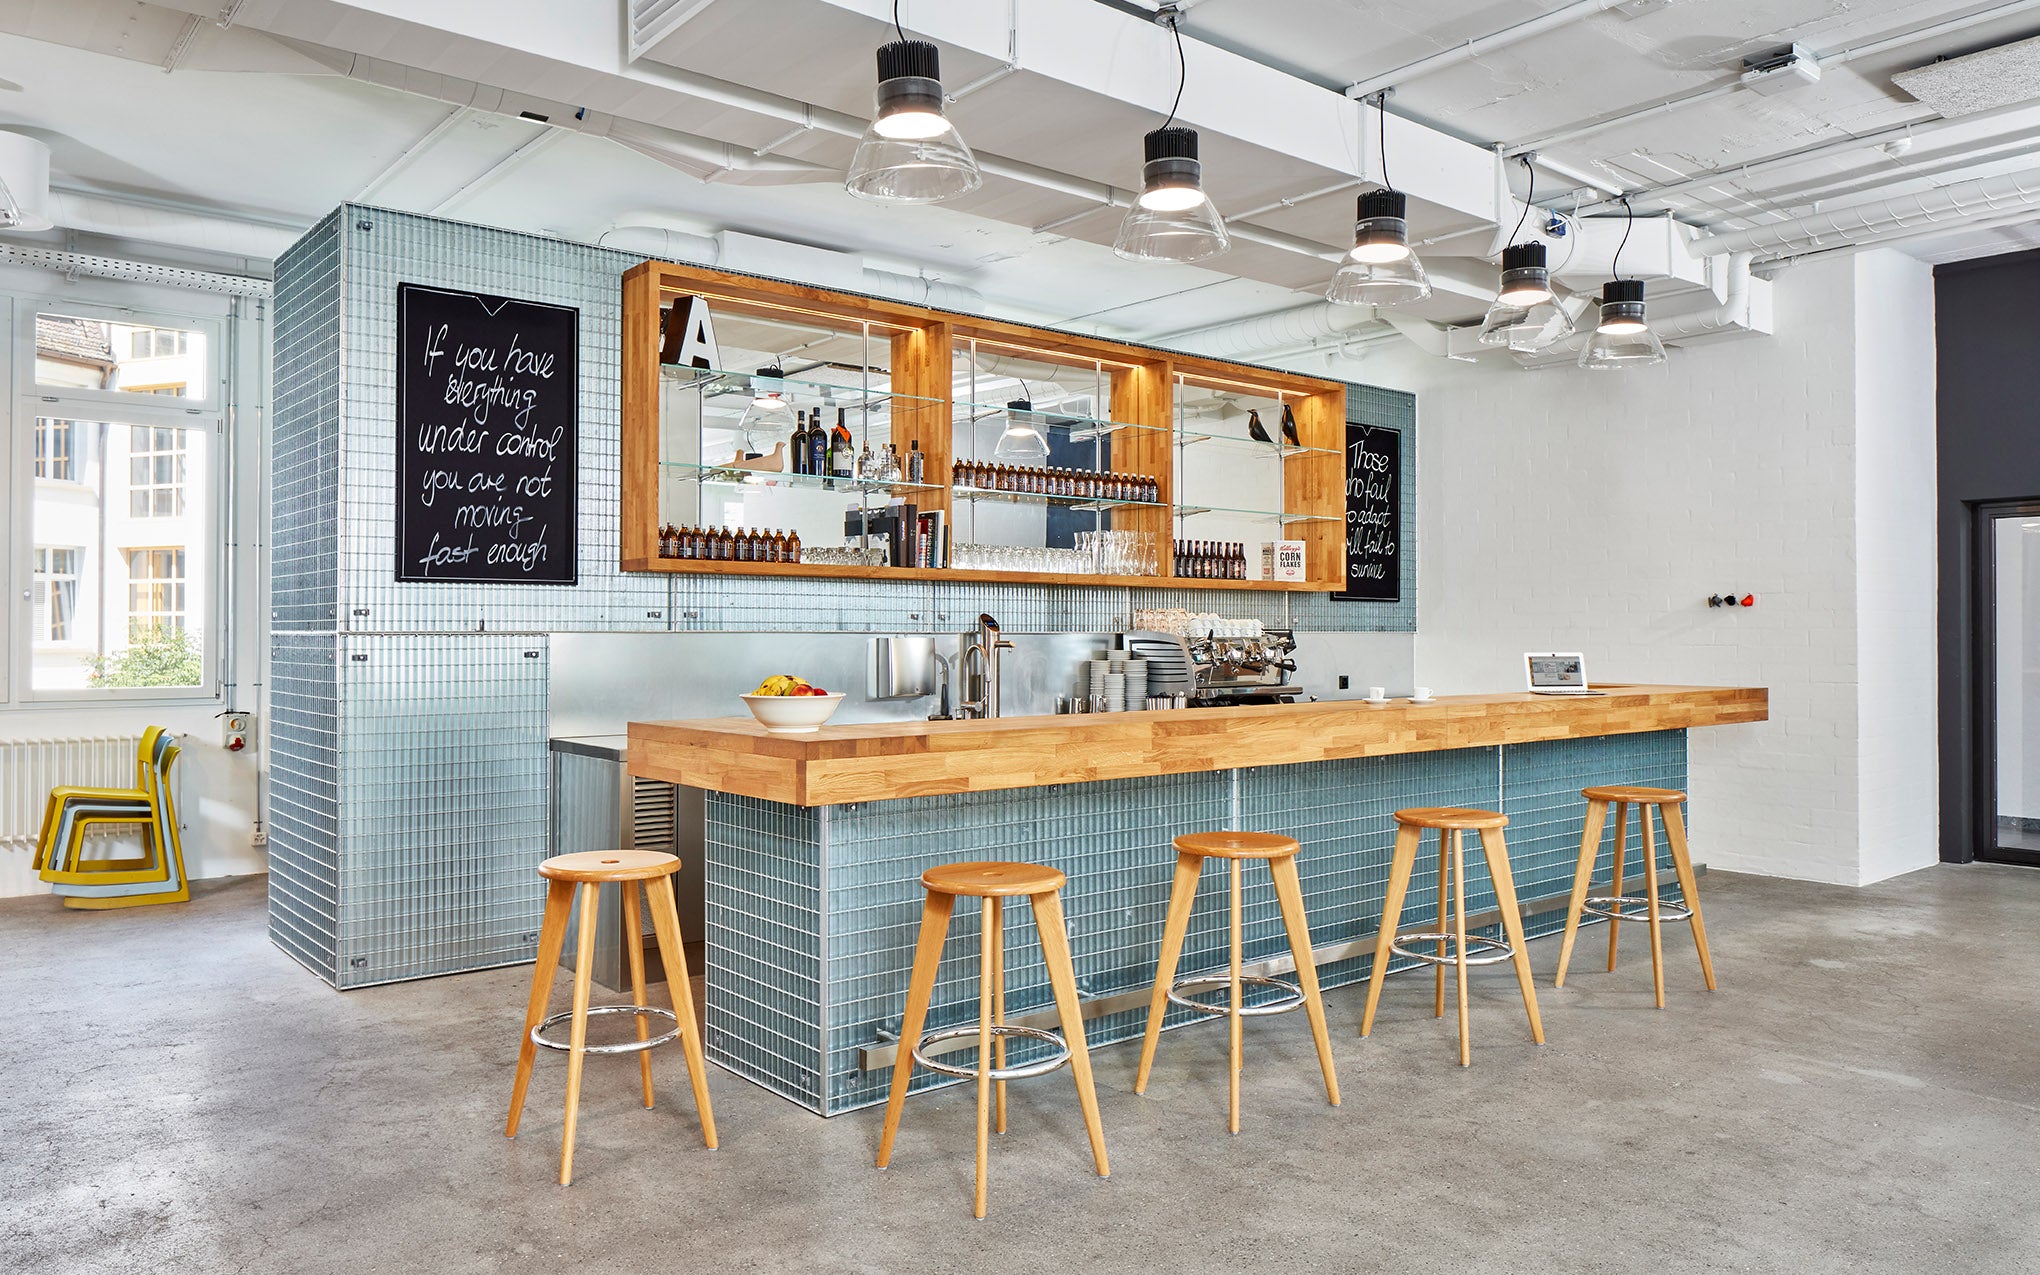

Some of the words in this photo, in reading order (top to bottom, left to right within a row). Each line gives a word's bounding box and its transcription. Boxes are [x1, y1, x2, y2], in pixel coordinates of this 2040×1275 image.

[677, 295, 723, 372] A
[424, 323, 448, 377] If
[455, 343, 498, 390] you
[503, 333, 554, 379] have
[418, 417, 489, 454] under
[496, 424, 564, 462] control
[1348, 440, 1389, 473] Those
[421, 469, 463, 507] you
[468, 472, 508, 493] are
[516, 465, 552, 497] not
[1365, 471, 1392, 509] fail
[454, 495, 534, 539] moving
[1358, 504, 1391, 533] adapt
[419, 532, 479, 576] fast
[487, 524, 547, 571] enough
[1279, 552, 1301, 561] CORN
[1364, 529, 1383, 559] fail
[1384, 530, 1395, 555] to
